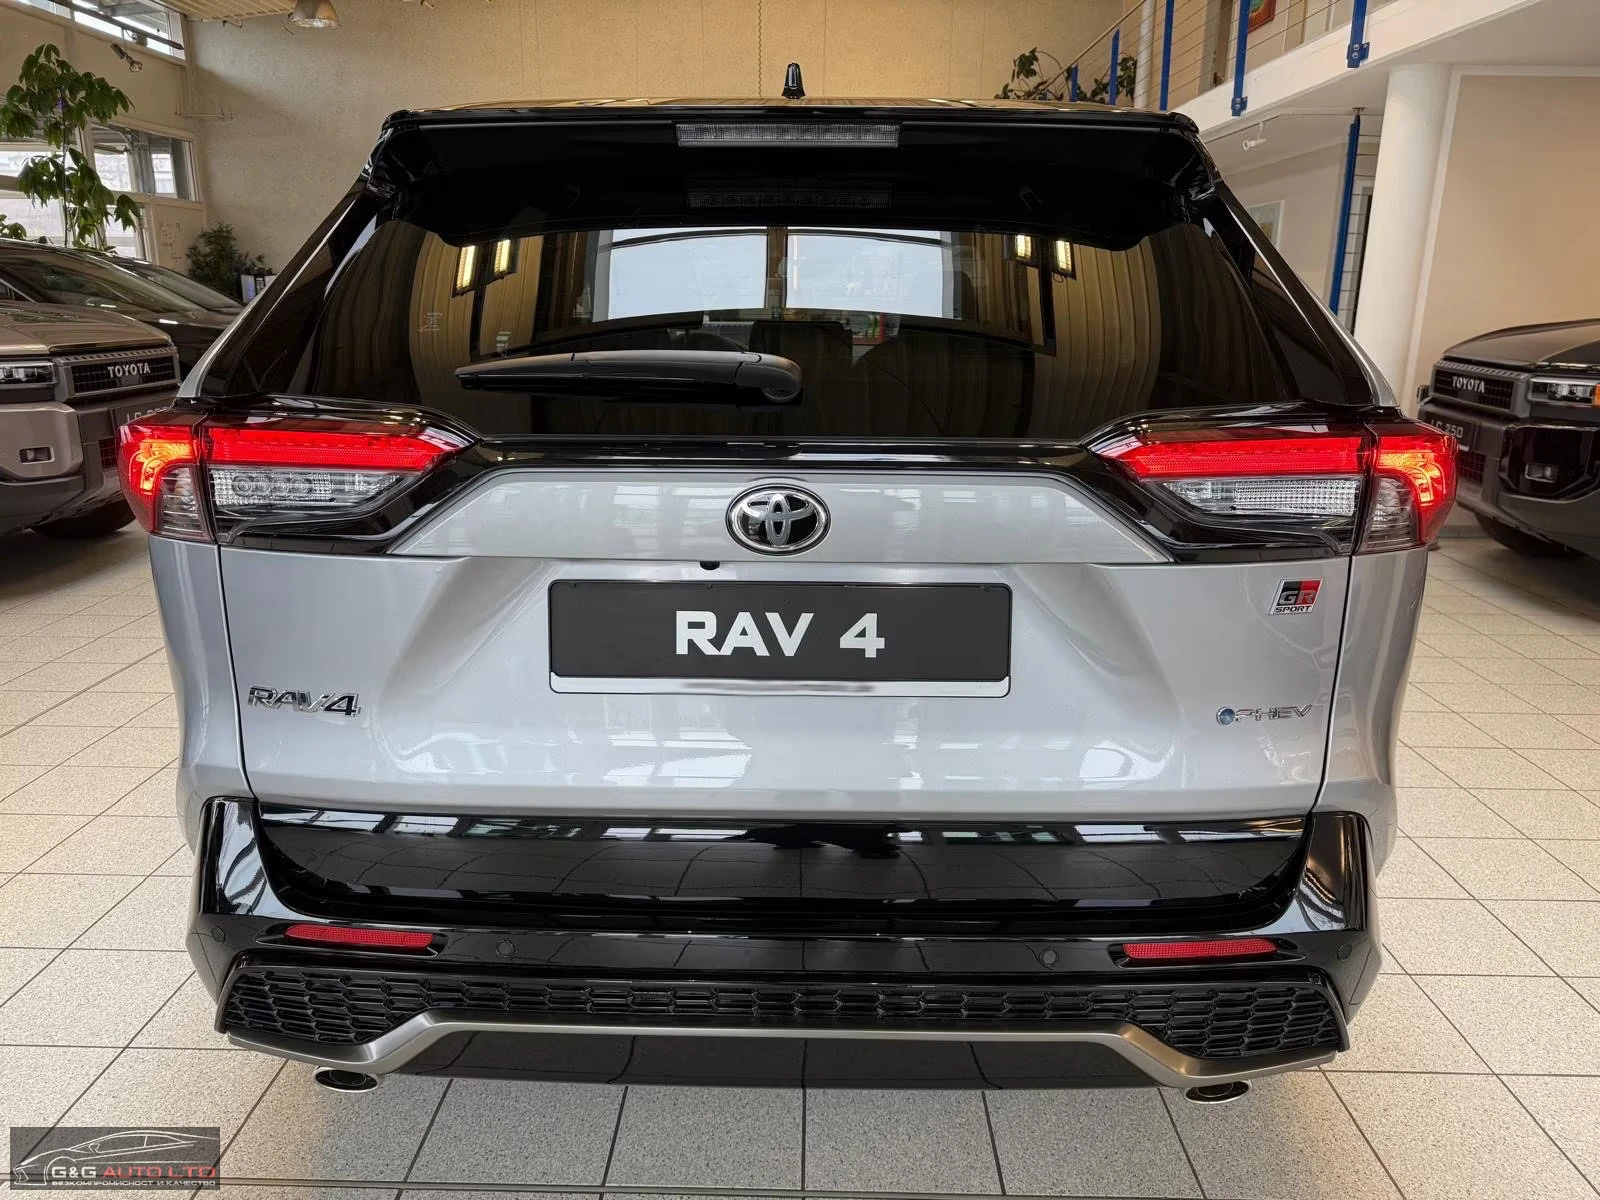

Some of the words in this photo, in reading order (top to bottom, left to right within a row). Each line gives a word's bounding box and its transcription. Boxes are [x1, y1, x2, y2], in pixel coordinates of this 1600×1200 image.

[107, 362, 151, 379] TOYOTA
[1452, 376, 1485, 393] TOYOTA
[1279, 590, 1317, 605] GR
[1275, 605, 1312, 613] SPORT
[675, 610, 814, 657] RAV
[839, 612, 886, 658] 4
[247, 685, 361, 718] RAV4
[1235, 704, 1313, 721] PHEV
